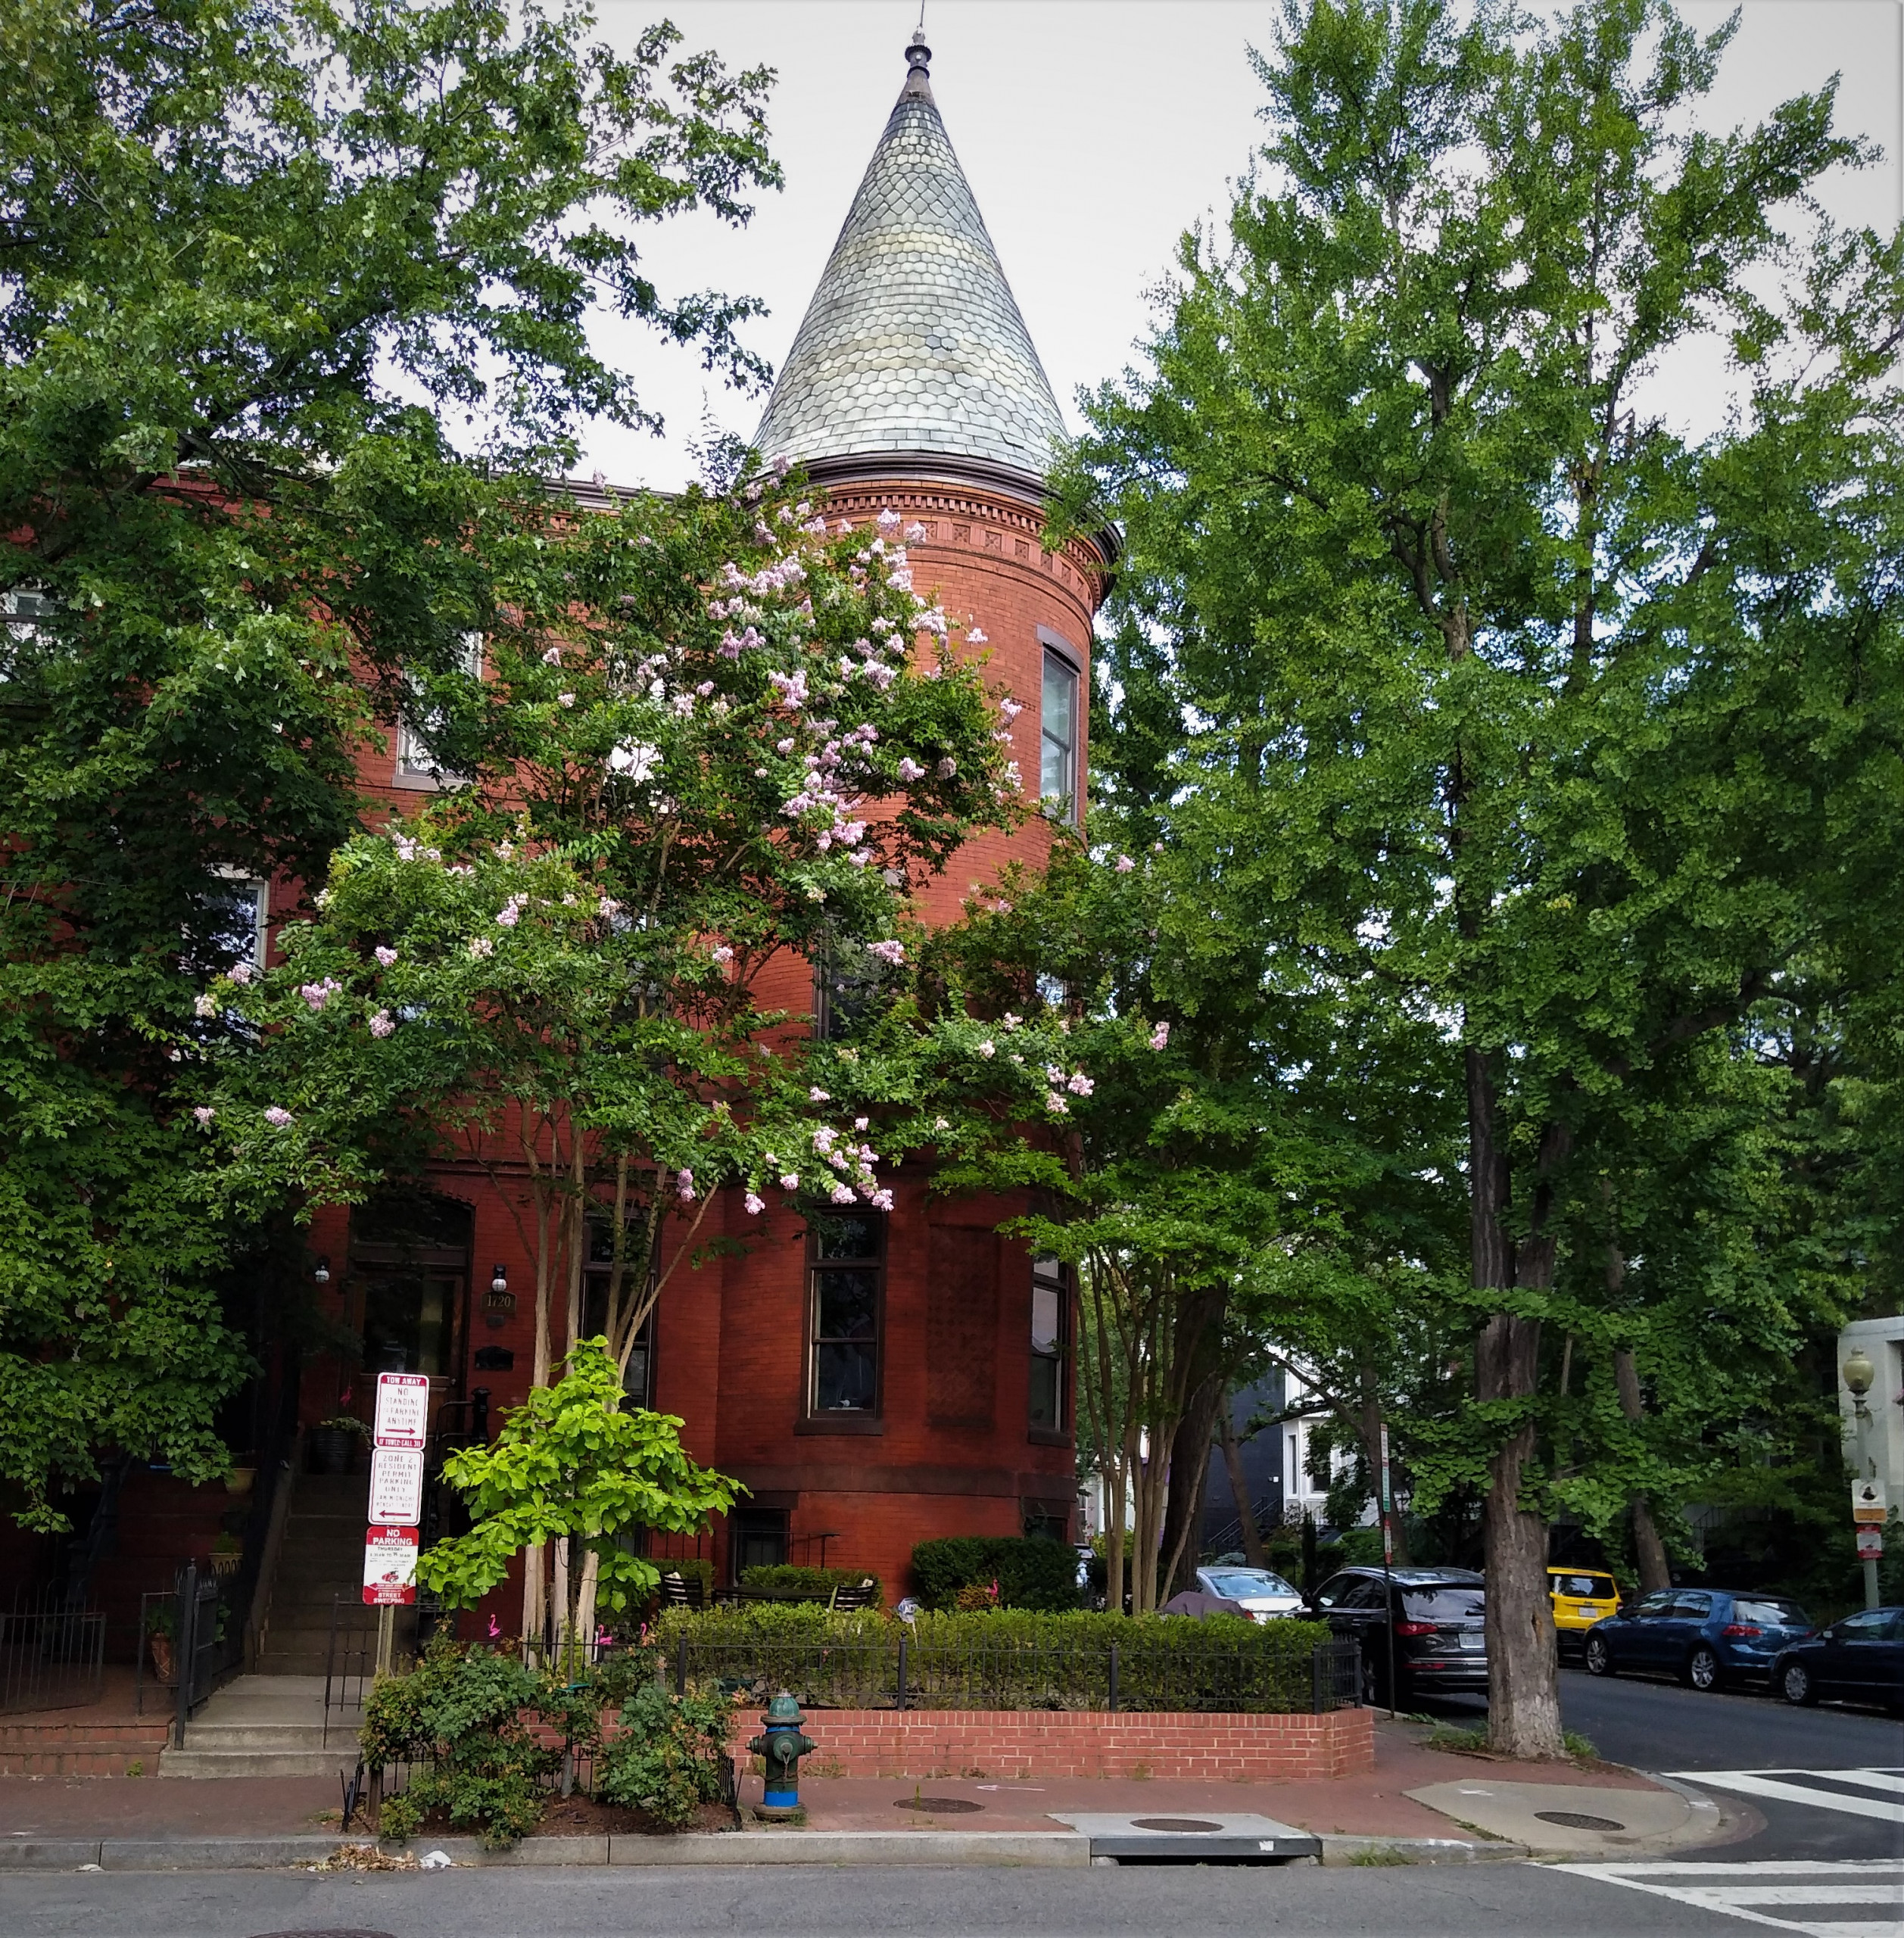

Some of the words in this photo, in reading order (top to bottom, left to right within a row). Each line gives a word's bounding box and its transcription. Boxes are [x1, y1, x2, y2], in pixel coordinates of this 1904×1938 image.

[488, 1295, 511, 1307] 1720
[402, 1377, 421, 1386] AWAY
[397, 1388, 409, 1396] NO
[401, 1439, 413, 1447] CALL
[383, 1454, 404, 1463] ZONE
[386, 1528, 400, 1538] NO
[372, 1537, 413, 1546] PARKING
